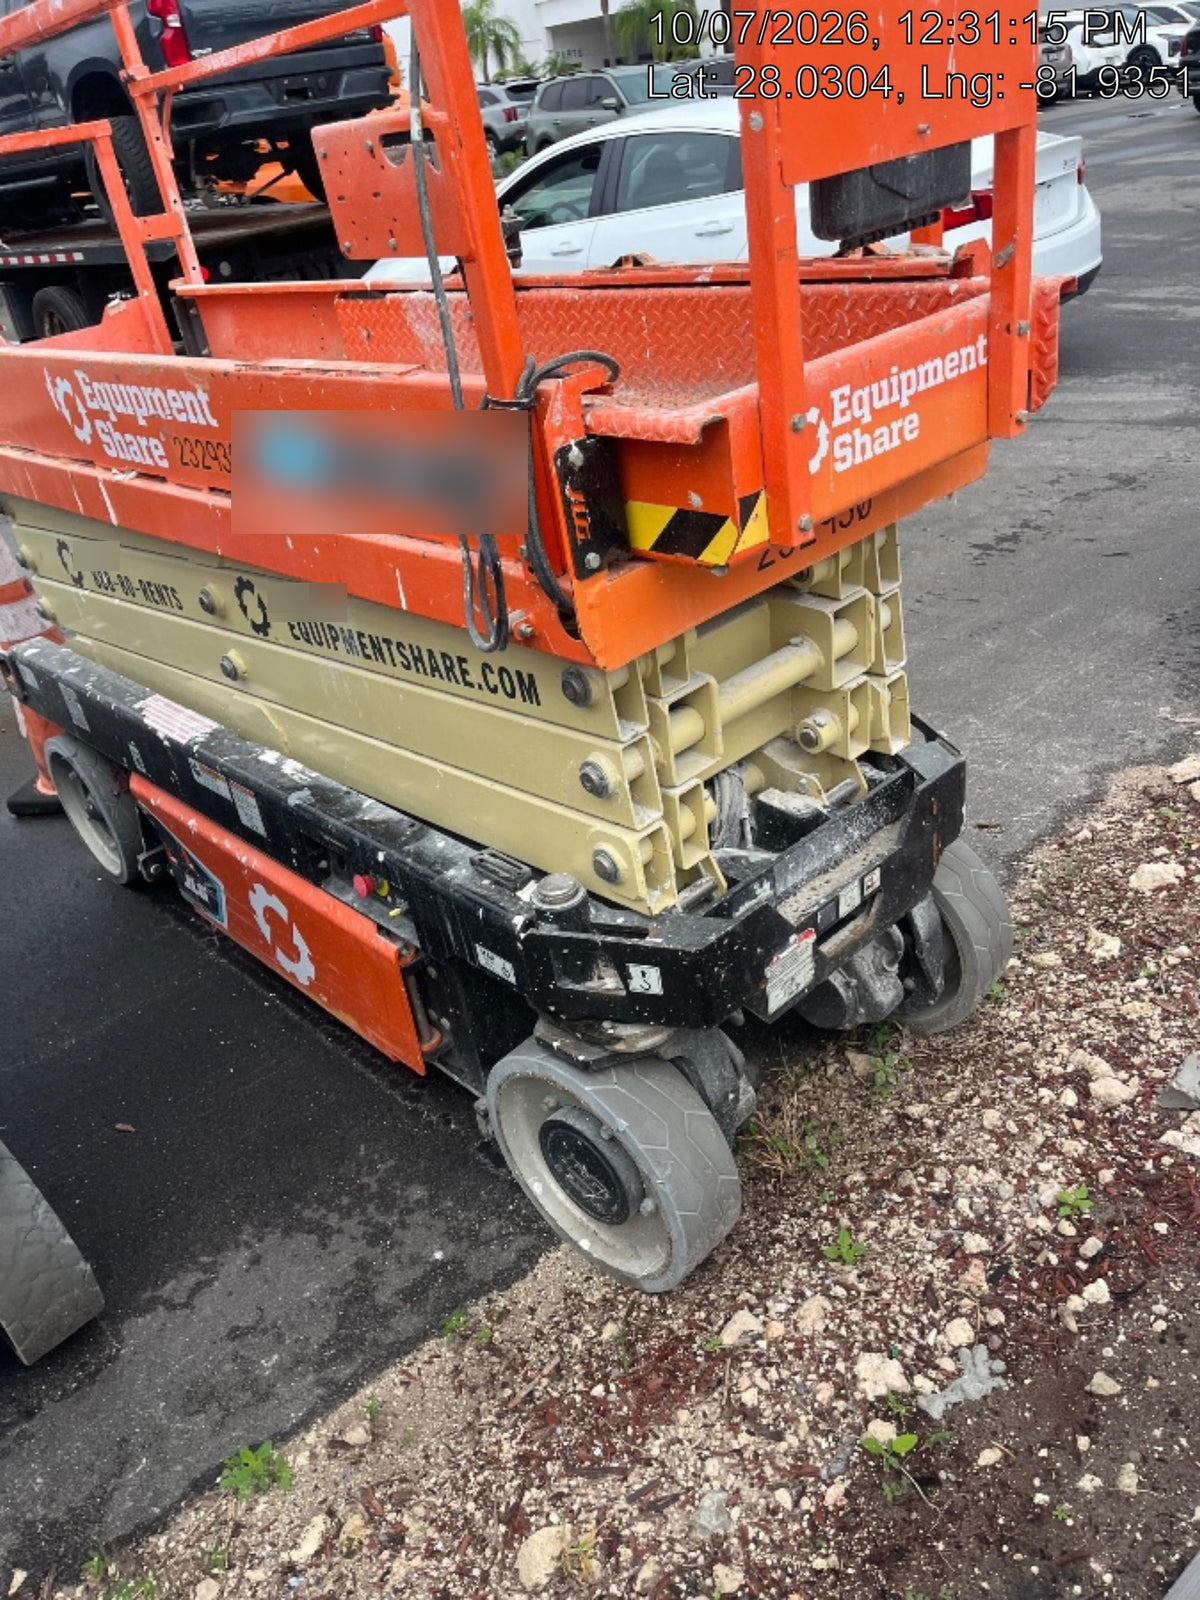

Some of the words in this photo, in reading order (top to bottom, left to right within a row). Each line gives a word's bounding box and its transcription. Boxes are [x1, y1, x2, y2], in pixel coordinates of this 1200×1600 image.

[74, 369, 219, 427] Equipment
[829, 333, 988, 429] Equipment
[95, 419, 170, 469] Share
[172, 436, 232, 474] 23293
[833, 411, 920, 473] Share
[287, 621, 542, 707] EQUIPMENTSHARE.COM
